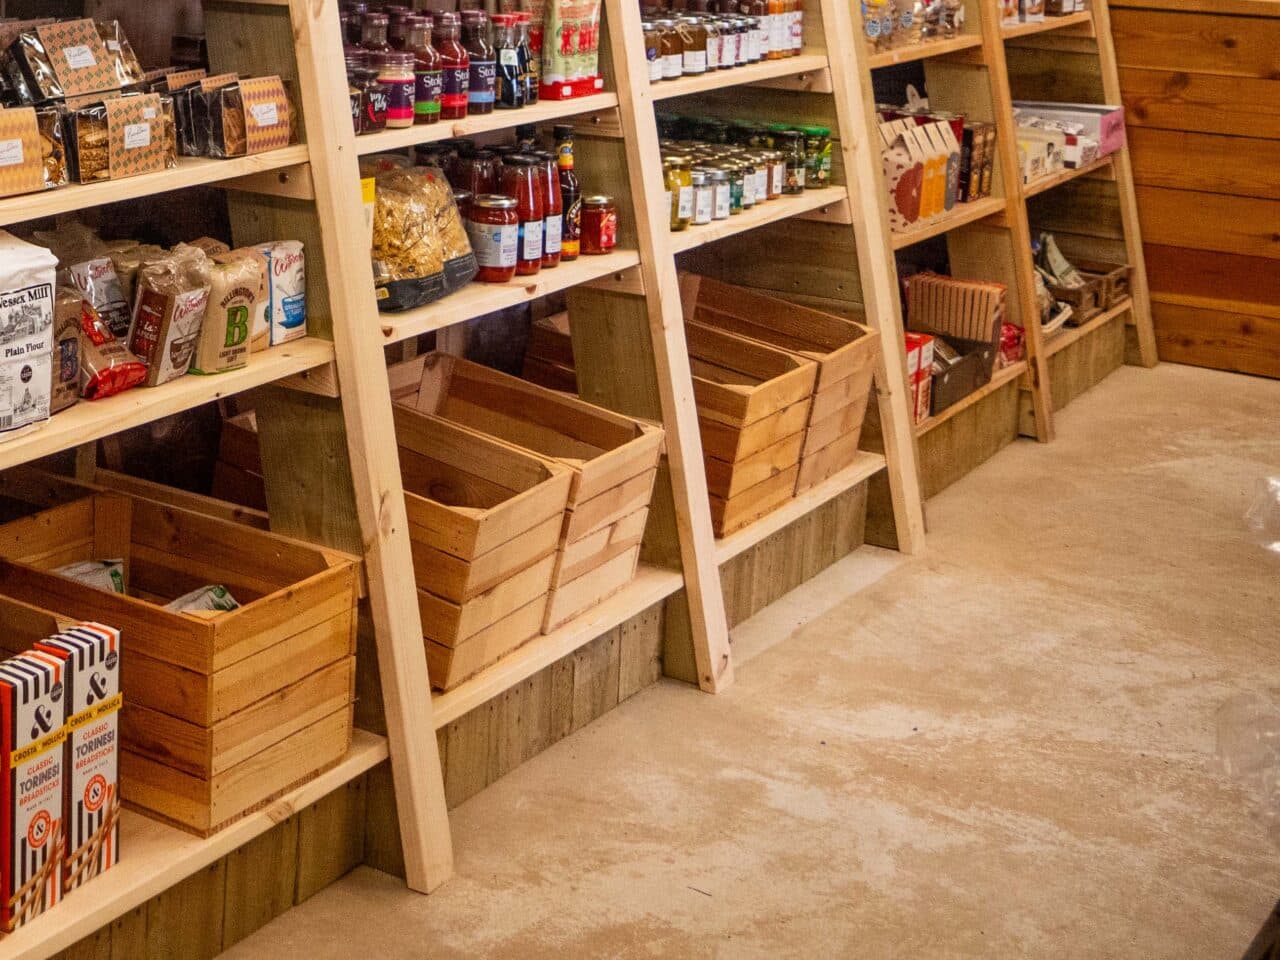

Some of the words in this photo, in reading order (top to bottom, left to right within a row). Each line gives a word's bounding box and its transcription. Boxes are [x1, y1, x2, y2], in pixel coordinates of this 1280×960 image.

[28, 287, 49, 302] Mill
[5, 346, 25, 358] Plain
[26, 341, 45, 354] Flour
[70, 712, 92, 727] CROSTA
[97, 699, 121, 715] MOLLICA
[76, 729, 116, 759] TORINESI
[83, 722, 108, 740] CLASSIC
[14, 746, 37, 762] CROSTA
[42, 730, 66, 747] MOLLICA
[76, 745, 115, 770] BREADSTICKS
[19, 763, 60, 795] TORINESI
[27, 756, 54, 776] CLASSIC
[20, 779, 60, 806] BREADSTICKS
